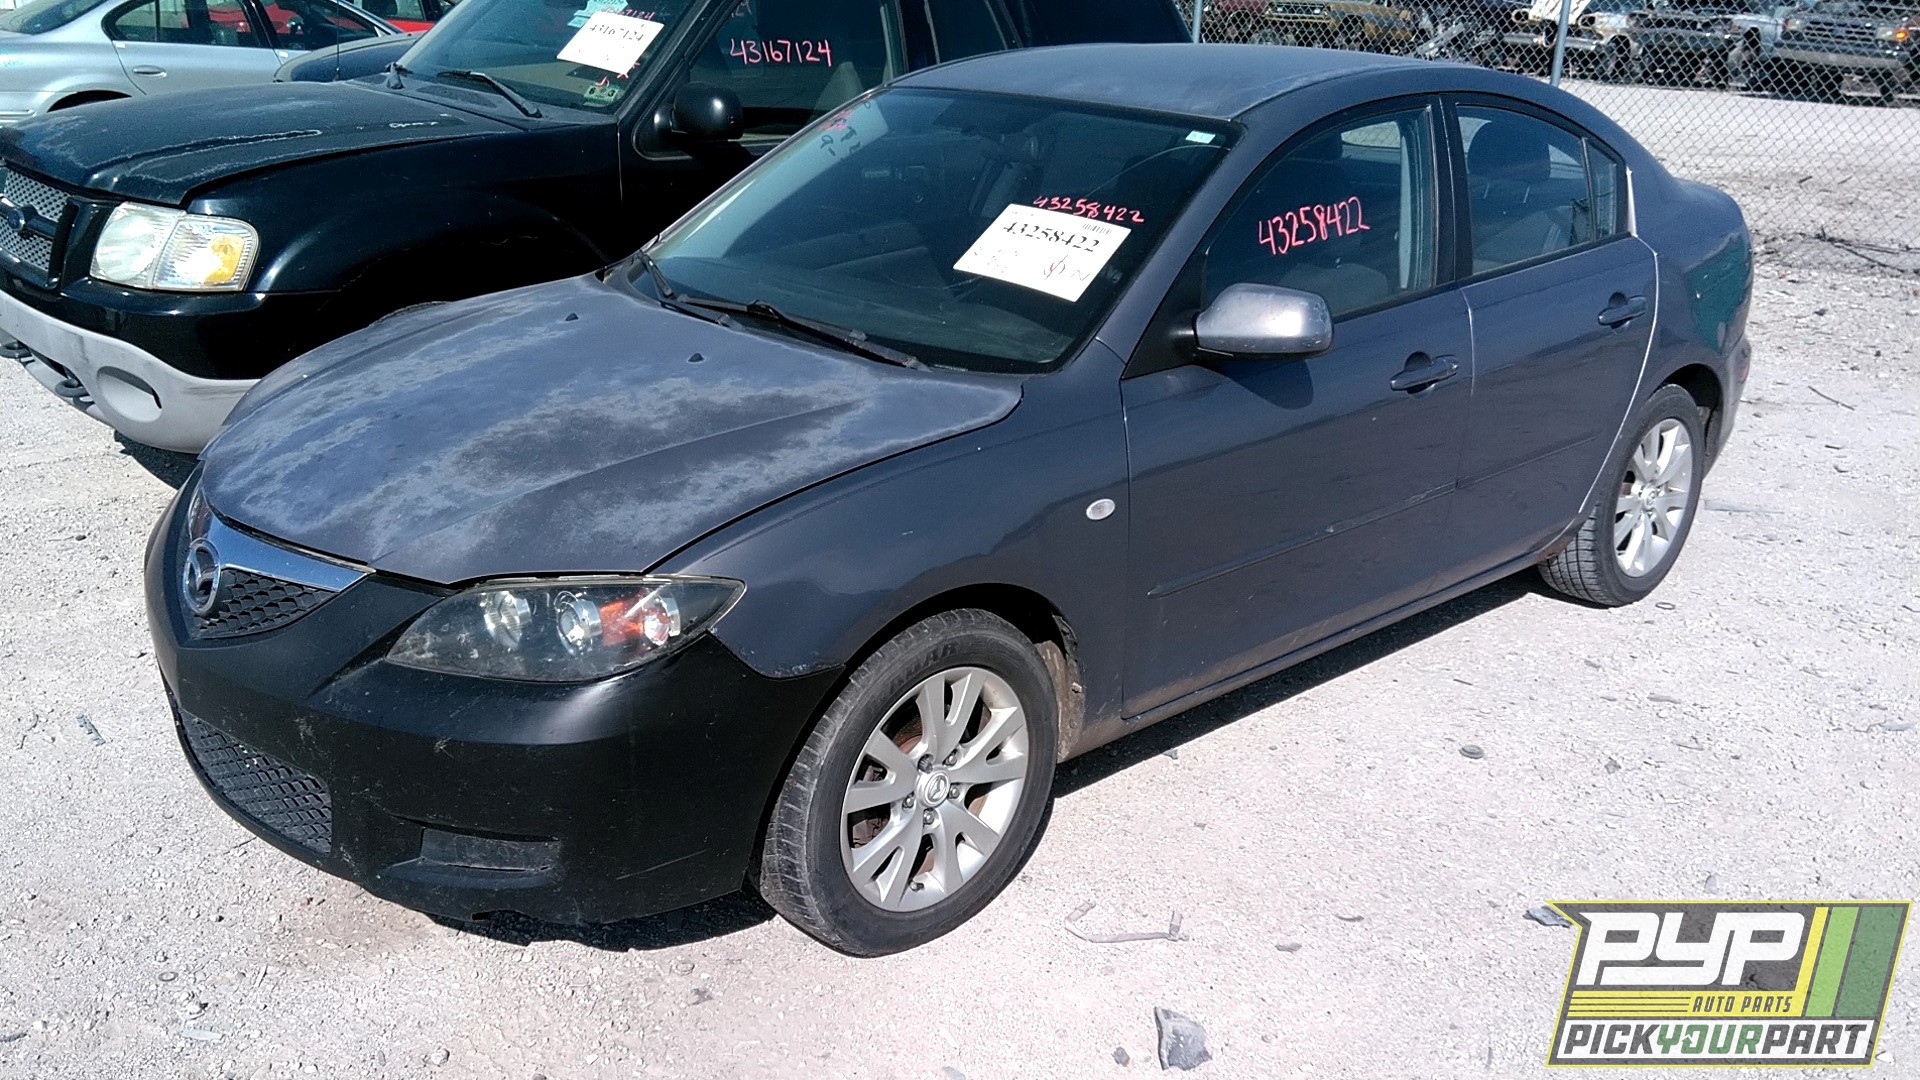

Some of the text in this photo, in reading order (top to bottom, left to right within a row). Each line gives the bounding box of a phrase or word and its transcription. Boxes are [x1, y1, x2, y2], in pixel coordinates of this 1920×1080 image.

[730, 38, 832, 68] 43167124
[1033, 195, 1145, 223] 43258422
[1003, 221, 1100, 253] 43258422
[1258, 196, 1371, 255] 43258422
